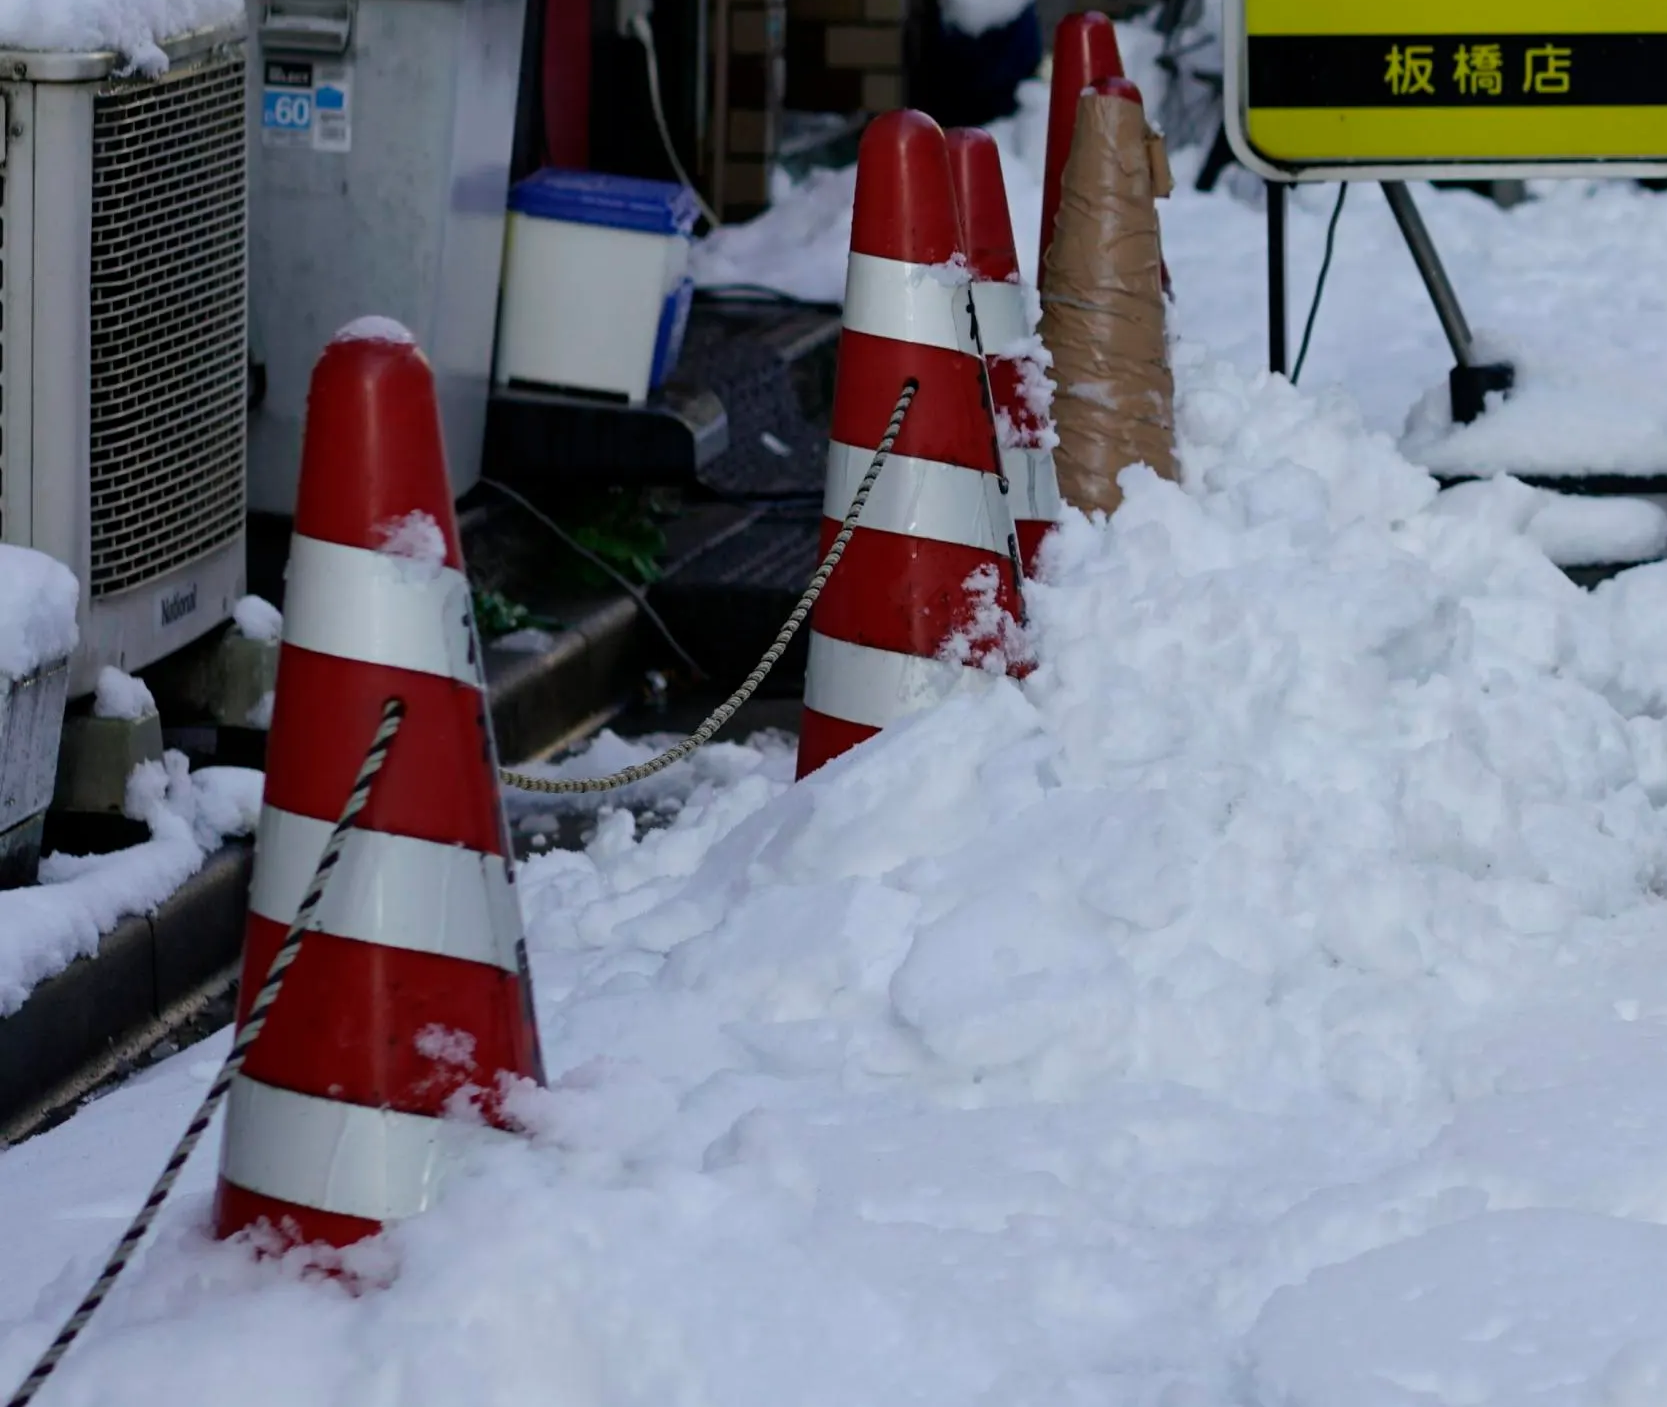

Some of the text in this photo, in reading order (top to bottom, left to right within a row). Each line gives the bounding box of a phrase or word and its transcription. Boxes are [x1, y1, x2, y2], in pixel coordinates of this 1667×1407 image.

[1383, 42, 1573, 96] 板橋店
[275, 95, 309, 127] 60
